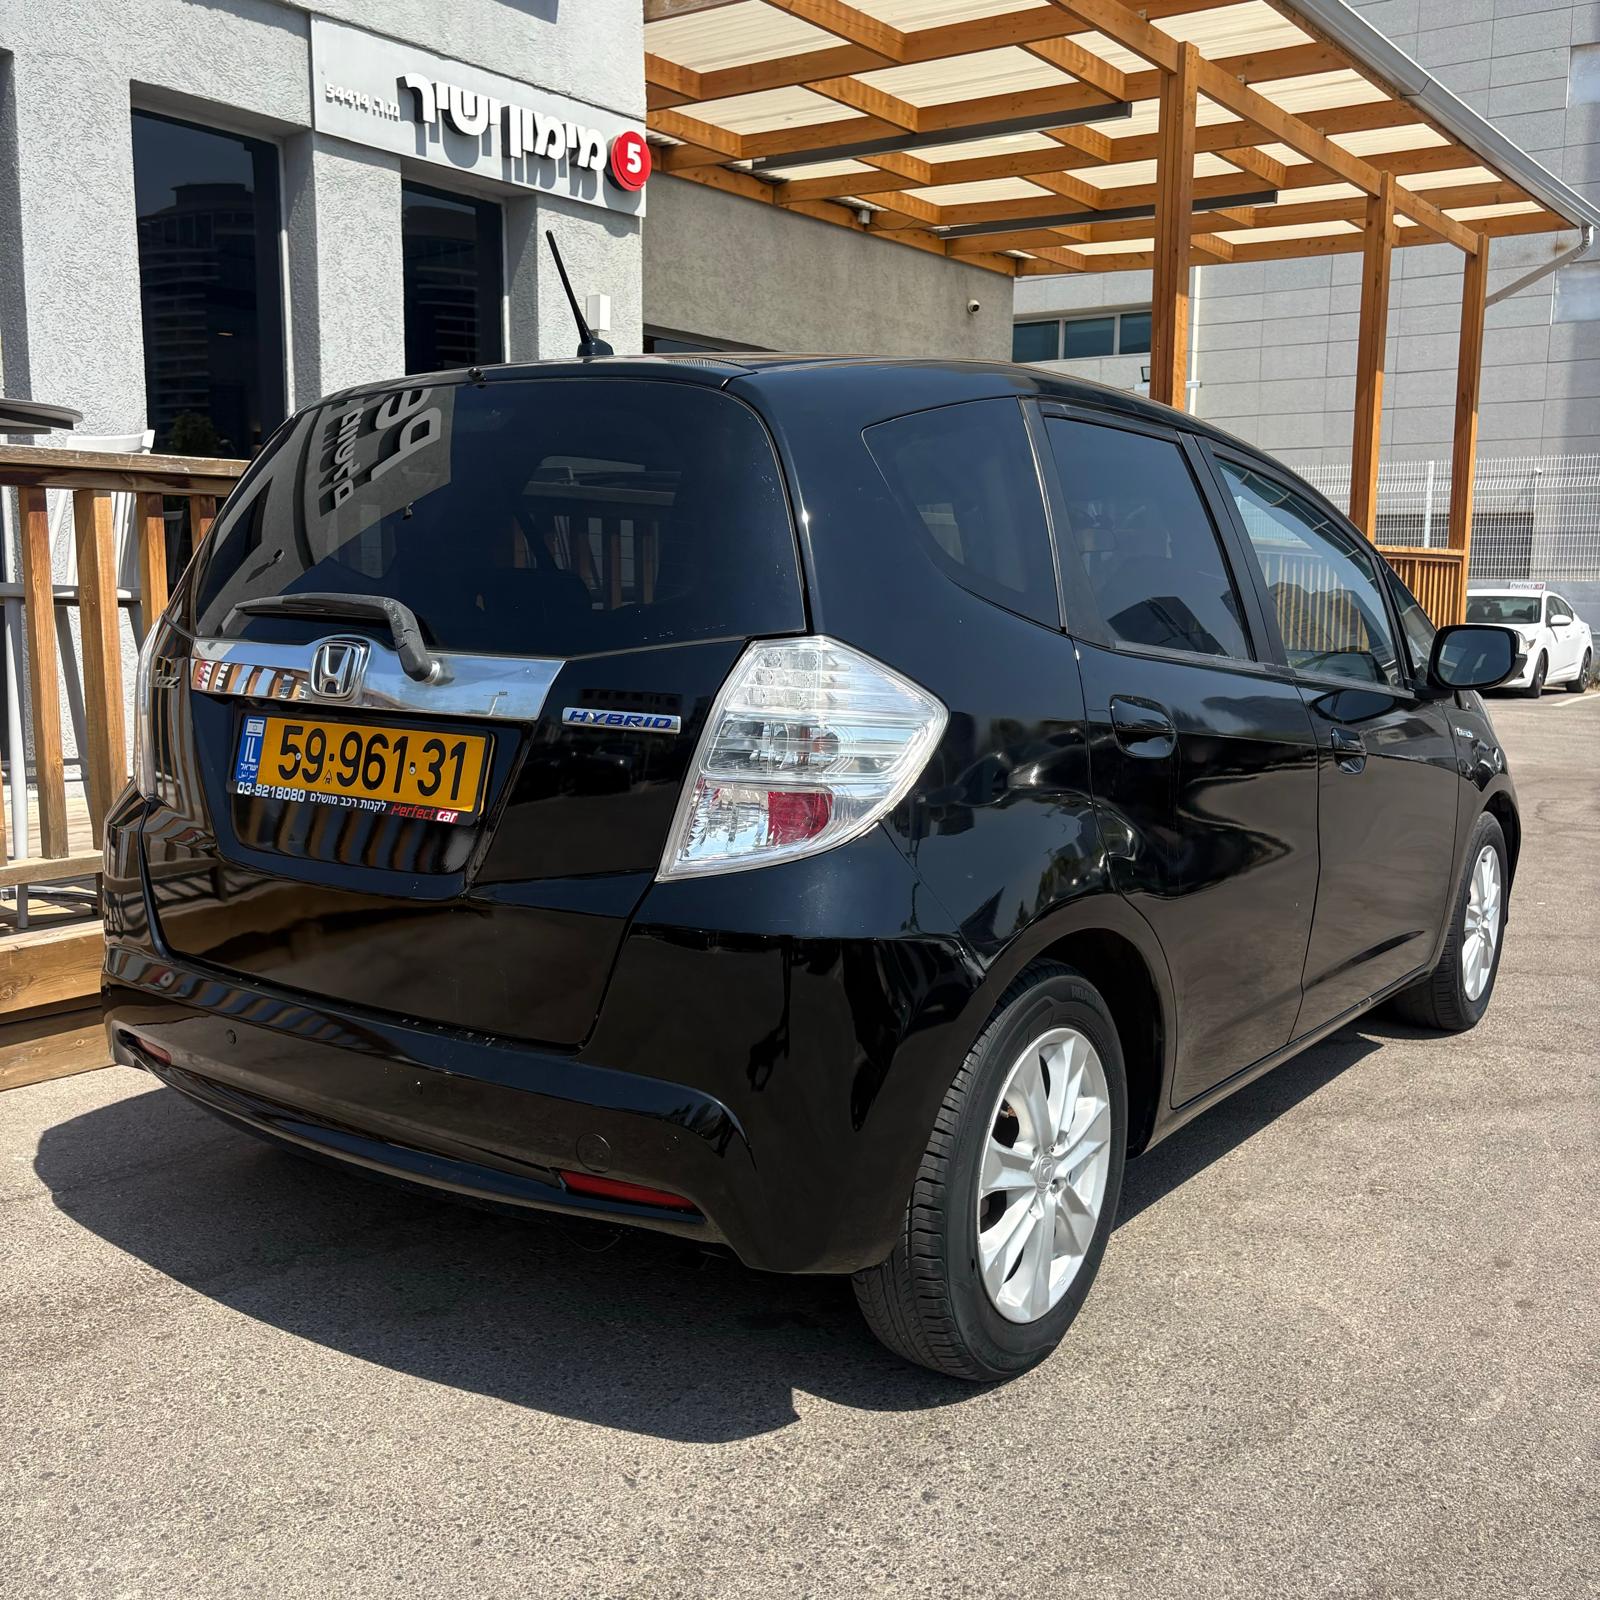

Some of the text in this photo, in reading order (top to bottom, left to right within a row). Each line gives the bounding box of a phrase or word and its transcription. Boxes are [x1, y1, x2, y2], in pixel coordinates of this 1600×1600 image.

[325, 82, 370, 109] 54414
[402, 72, 642, 174] 5 מימון ישיר
[568, 710, 673, 729] HYBRID
[244, 737, 258, 763] IL
[237, 781, 306, 803] 03-9218080
[309, 791, 387, 813] לקנות רכב מושלם
[390, 803, 459, 823] Perfect car
